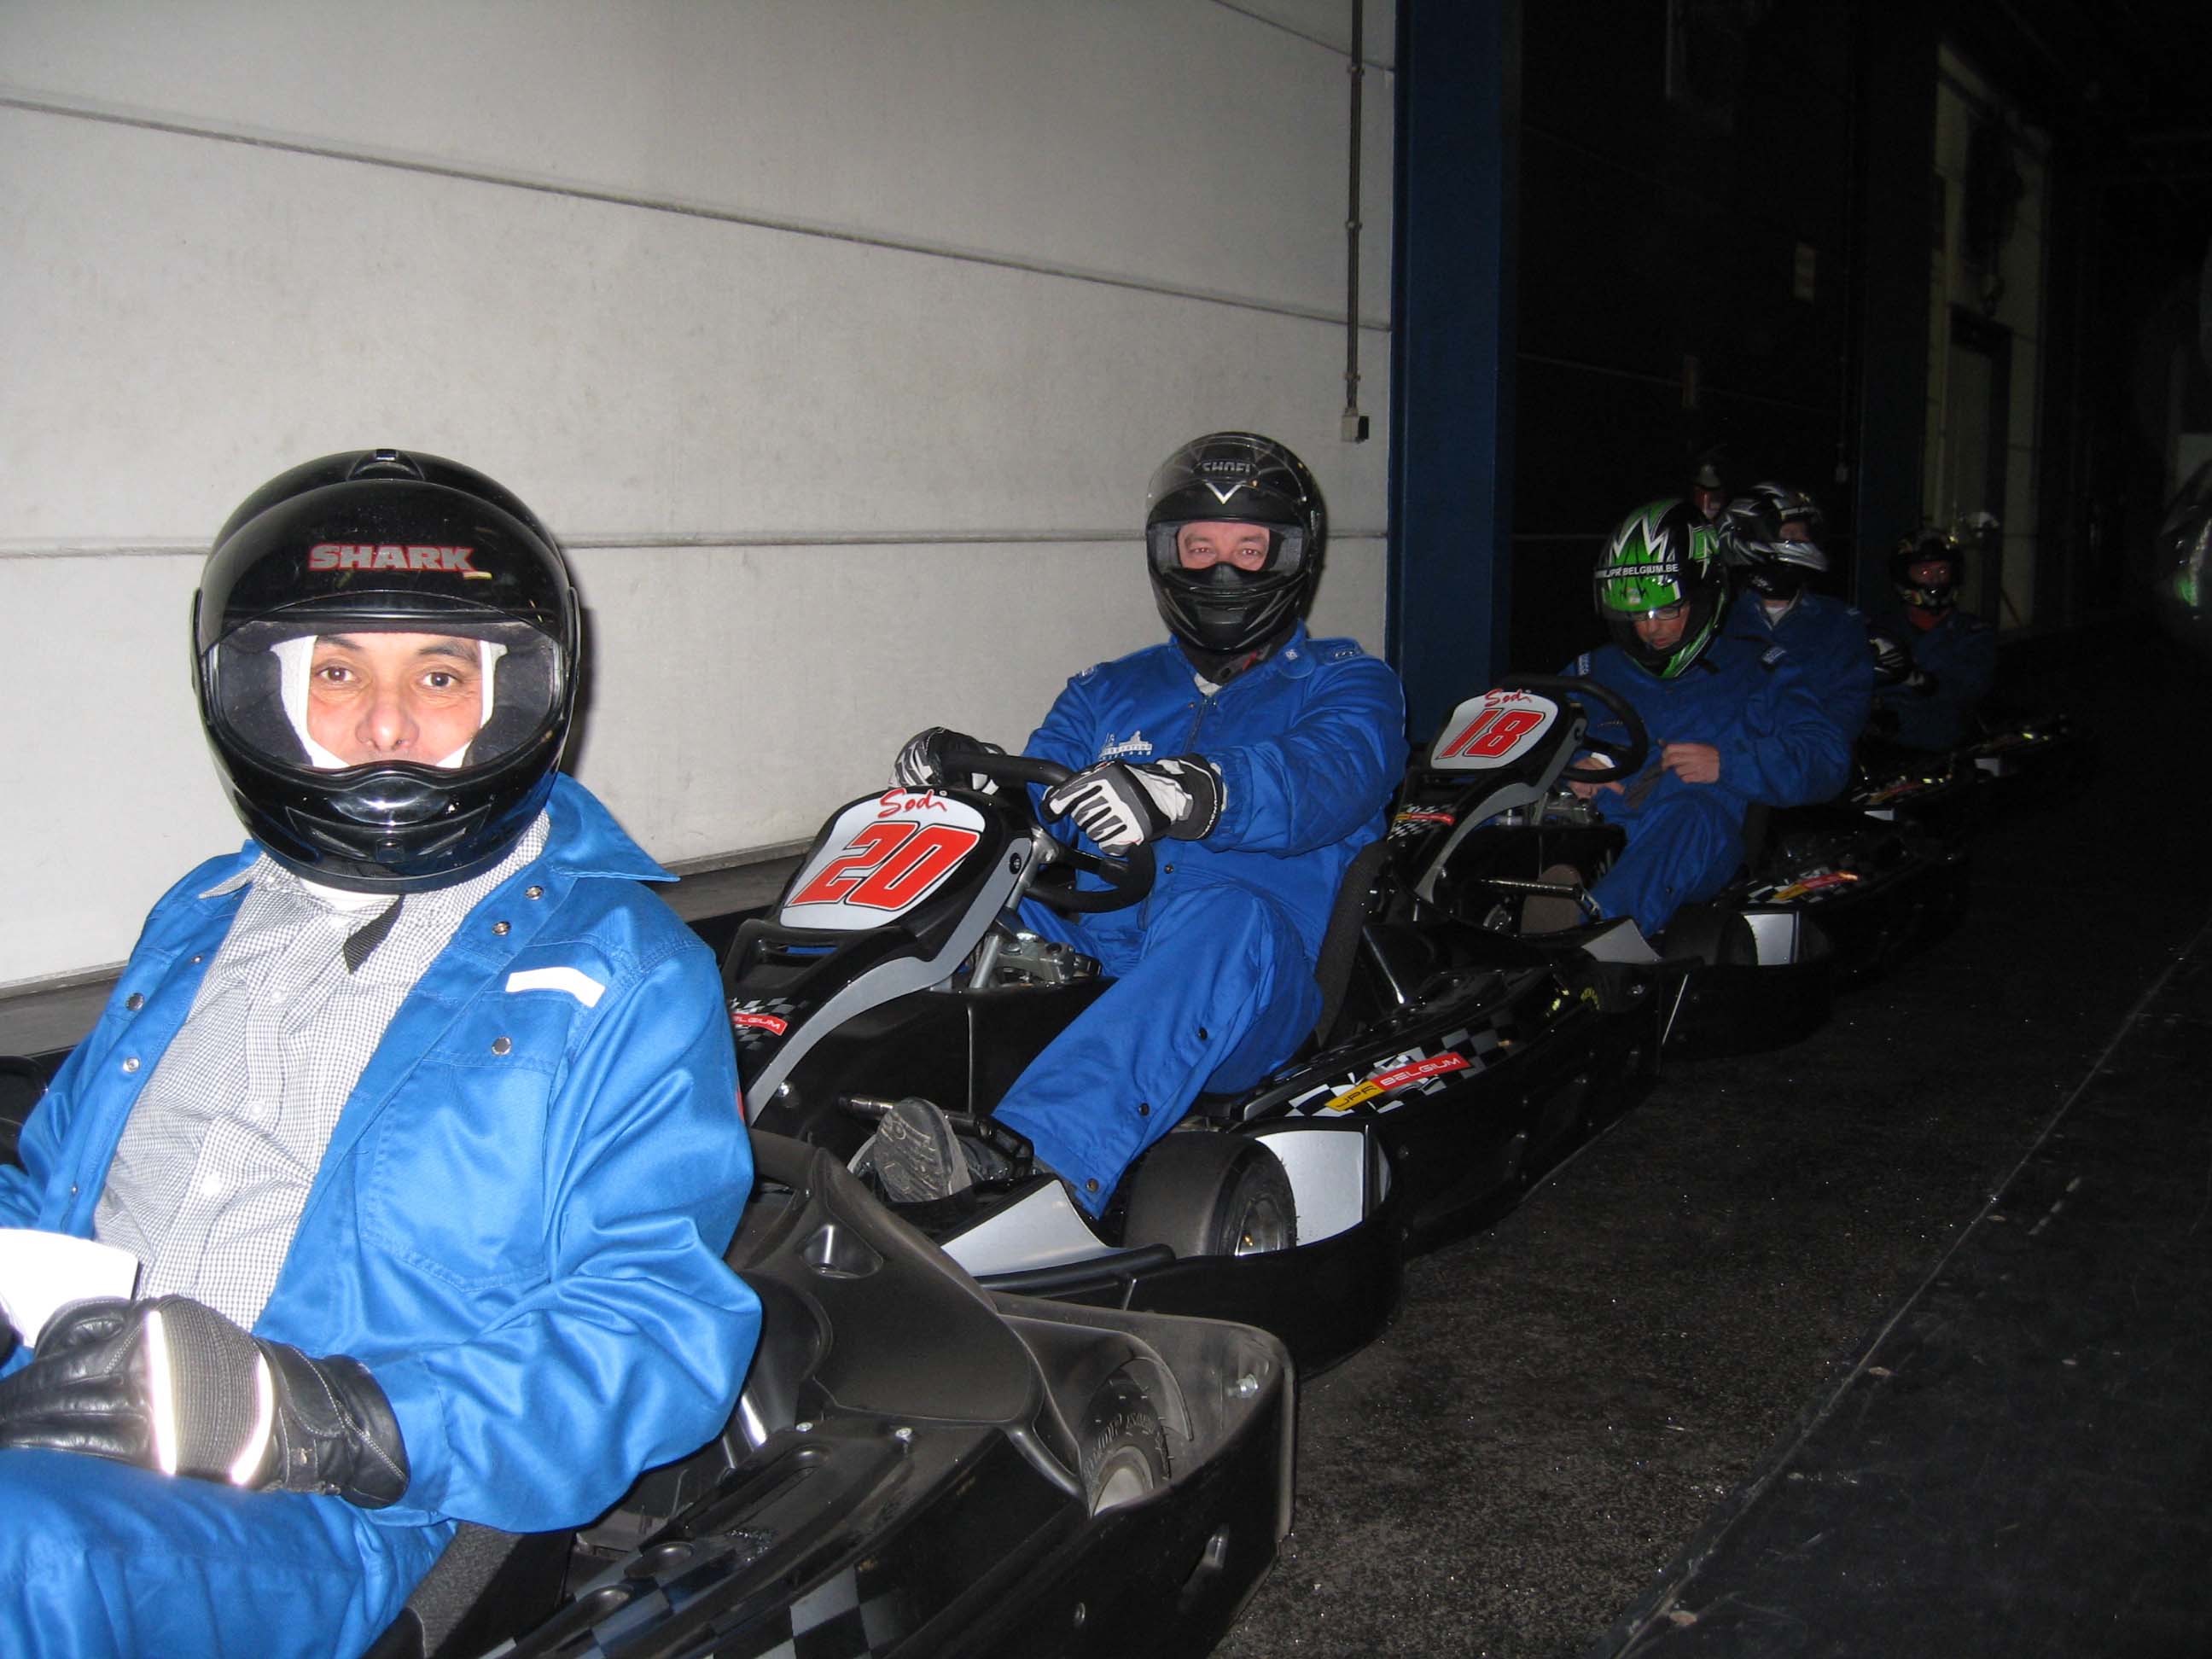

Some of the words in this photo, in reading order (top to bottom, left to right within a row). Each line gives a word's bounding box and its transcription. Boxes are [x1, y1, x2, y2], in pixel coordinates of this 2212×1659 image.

[308, 542, 476, 573] SHARK
[1483, 687, 1533, 707] Sodi
[1435, 707, 1545, 759] 18
[877, 787, 948, 818] Sodi
[783, 820, 981, 911] 20
[1379, 1057, 1463, 1087] BELGIUM
